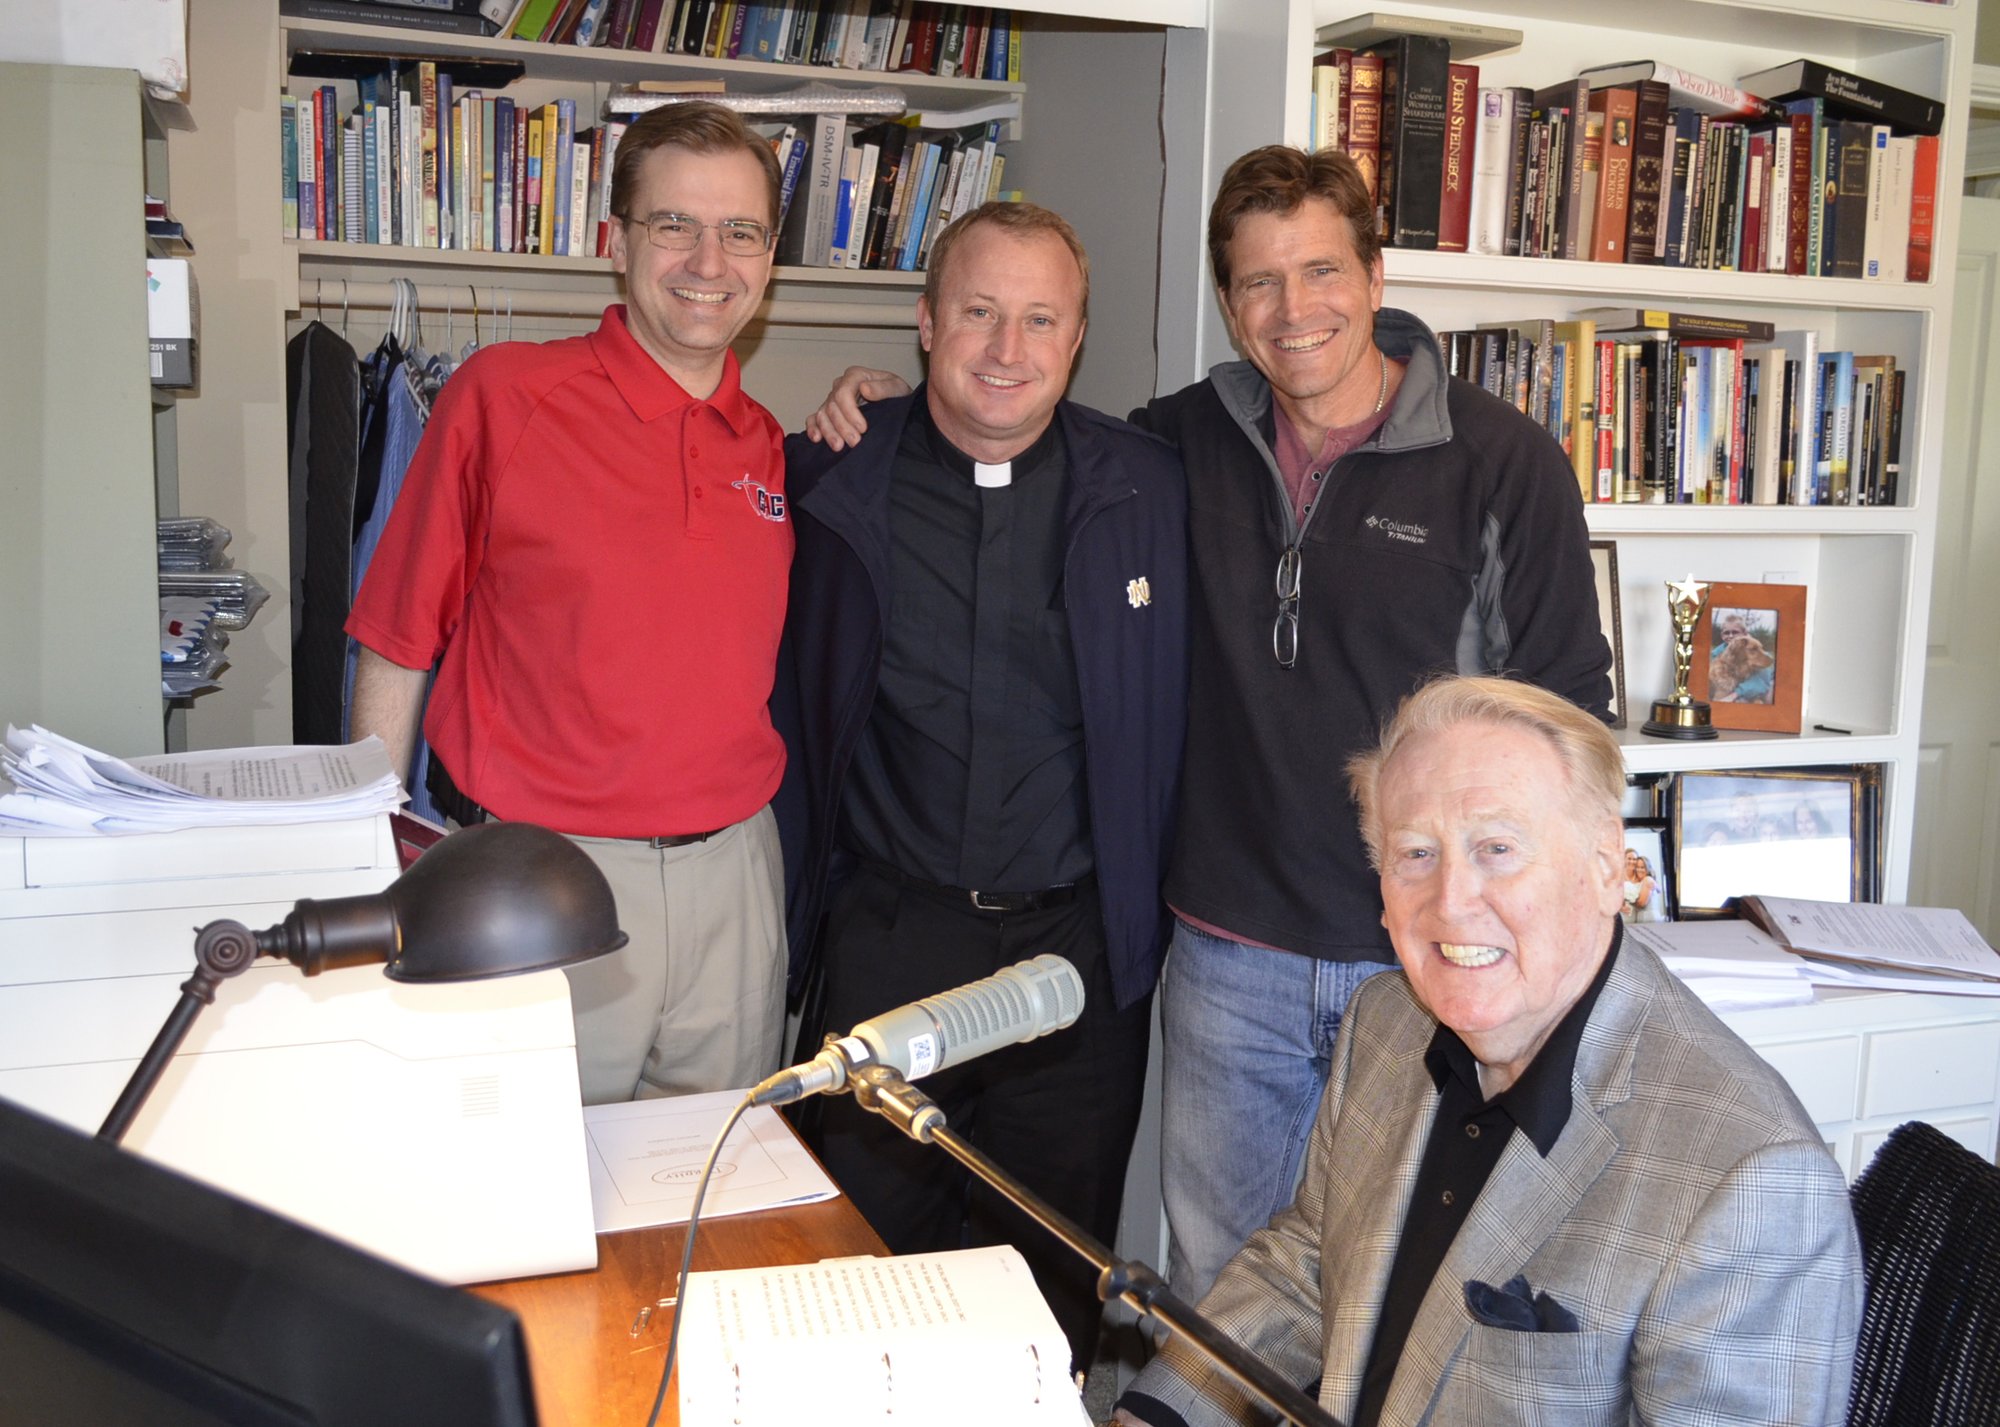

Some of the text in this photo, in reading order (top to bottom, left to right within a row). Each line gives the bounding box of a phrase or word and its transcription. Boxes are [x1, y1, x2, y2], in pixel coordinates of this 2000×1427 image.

[734, 4, 746, 35] LUCADO
[1409, 91, 1442, 102] COMPLETE
[1676, 69, 1739, 105] Nelson DeMille
[1825, 82, 1884, 109] The Fountainhead
[1826, 72, 1859, 90] Ayn Rand
[422, 77, 437, 128] CHILDREN
[1403, 107, 1445, 120] SHAKESPEARE
[1408, 100, 1432, 109] WORKS
[1578, 88, 1587, 114] Robert
[1447, 76, 1468, 192] JOHN STEINBECK
[1701, 115, 1709, 133] HEART
[365, 125, 375, 180] LOVE DOES
[518, 148, 525, 159] MY
[593, 141, 602, 158] Family
[1697, 140, 1706, 168] DARKNESS
[424, 154, 435, 192] SANTROCK
[502, 152, 510, 182] ADDICTION
[517, 163, 525, 184] SOUL
[593, 159, 601, 181] Crucible
[780, 155, 800, 190] Emotional
[1512, 123, 1527, 228] UNCLE TOM'S CABIN
[1573, 144, 1582, 194] IRON JOHN
[1606, 158, 1620, 208] DICKENS
[1615, 158, 1628, 210] CHARLES
[573, 194, 583, 245] PLAY THERAPY
[1810, 175, 1820, 257] ALCHEMIST
[1405, 228, 1435, 236] HarperCollins
[165, 343, 177, 351] BK
[1508, 341, 1516, 374] HE STILL
[1773, 401, 1781, 450] Contemplation
[1838, 407, 1847, 461] FORGIVING
[1824, 429, 1832, 460] SHACK
[1379, 518, 1428, 536] Columbia
